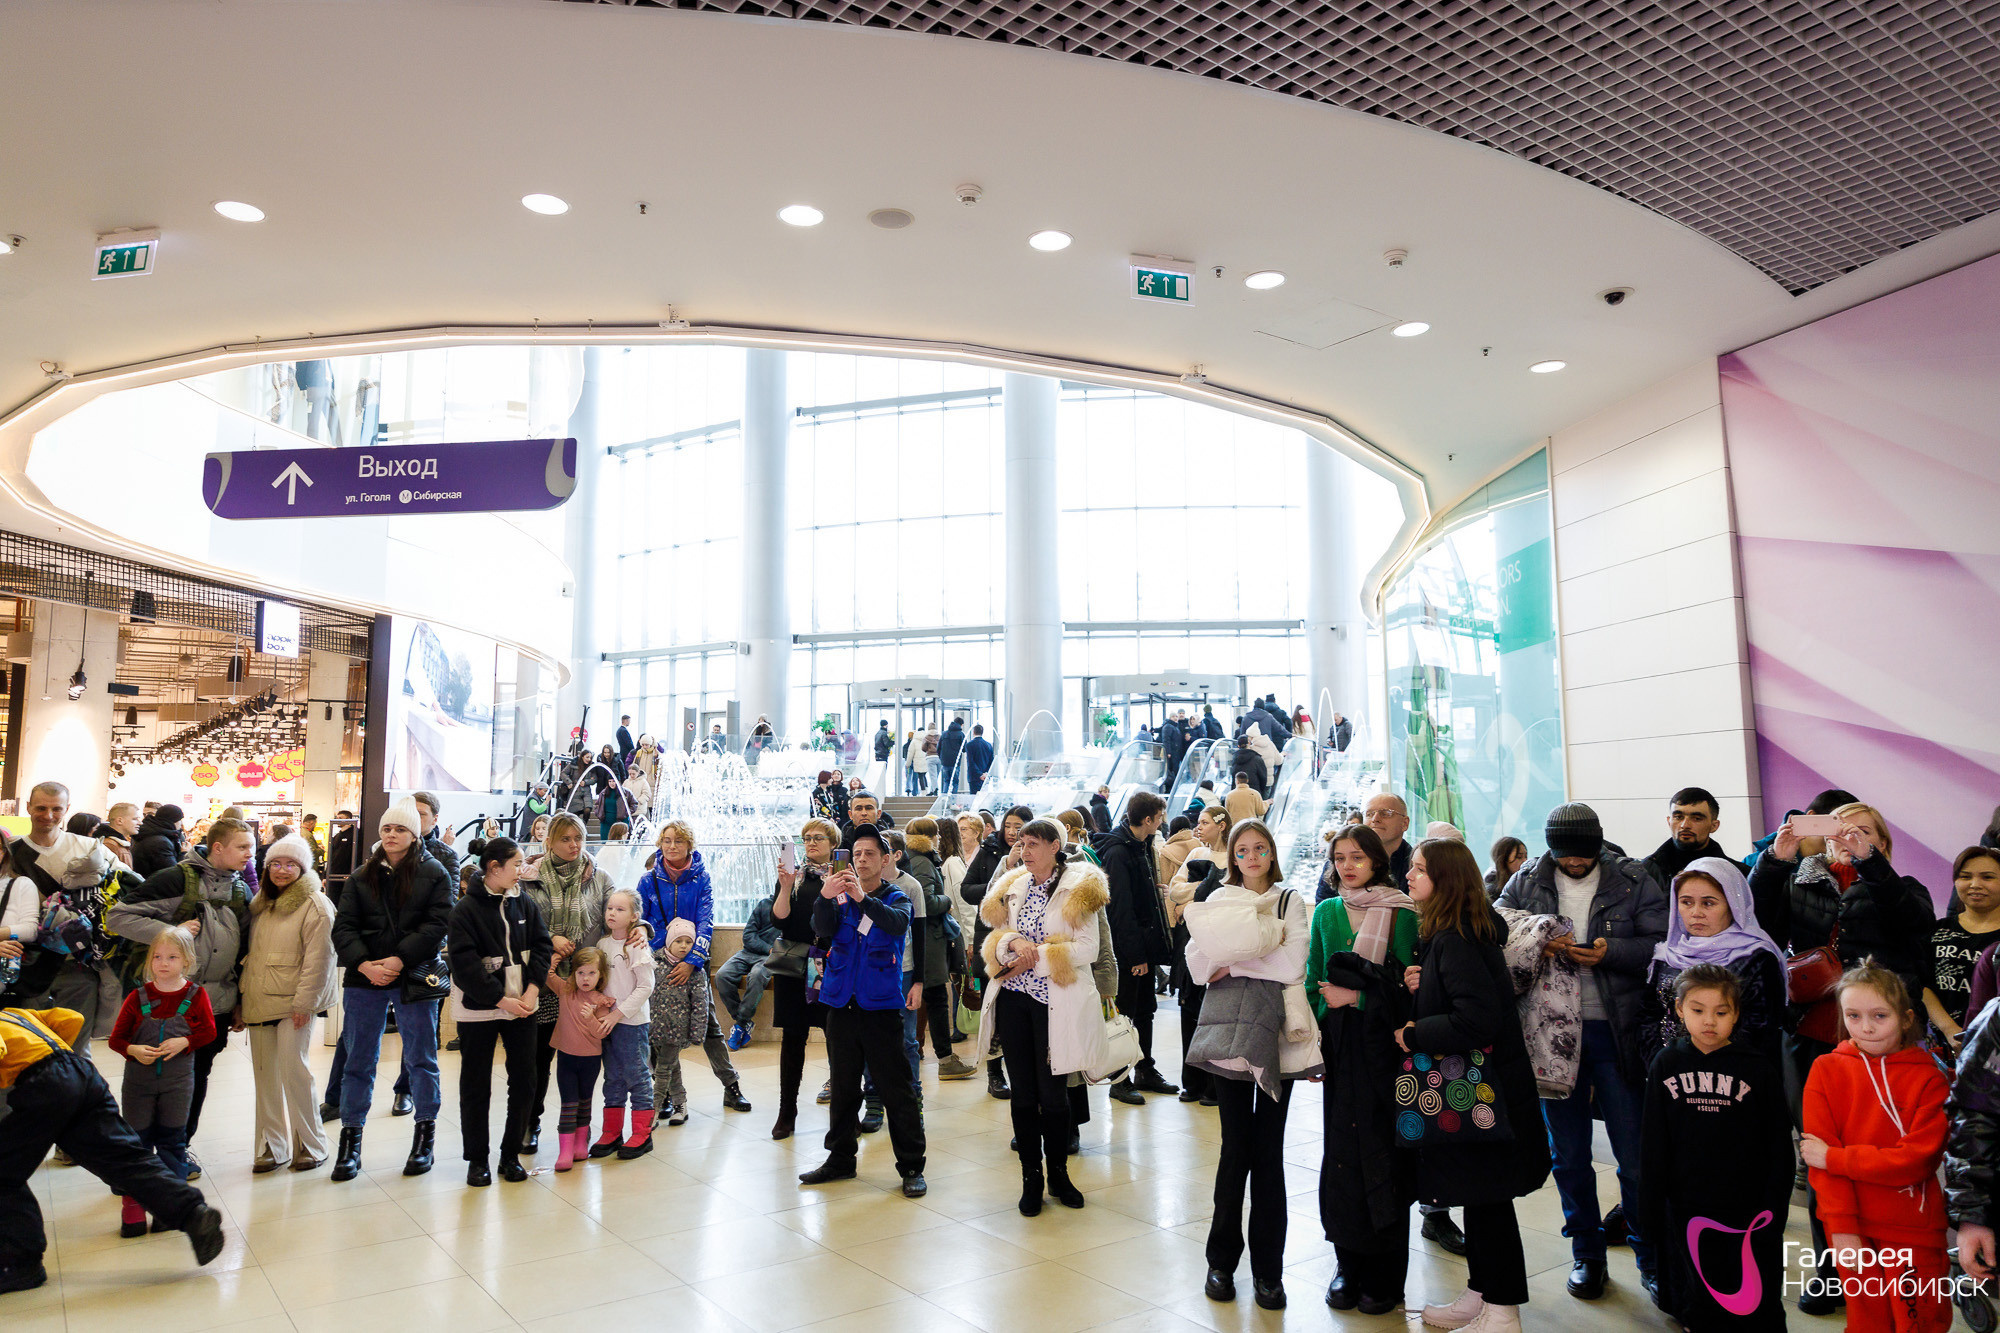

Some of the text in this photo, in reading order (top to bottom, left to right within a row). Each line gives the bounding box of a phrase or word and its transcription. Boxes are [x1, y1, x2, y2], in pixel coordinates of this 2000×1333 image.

[358, 454, 438, 480] Выход
[345, 495, 358, 504] ул.
[360, 493, 391, 502] Гоголя
[413, 491, 462, 501] Сибирская
[1663, 1071, 1751, 1102] FUNNY
